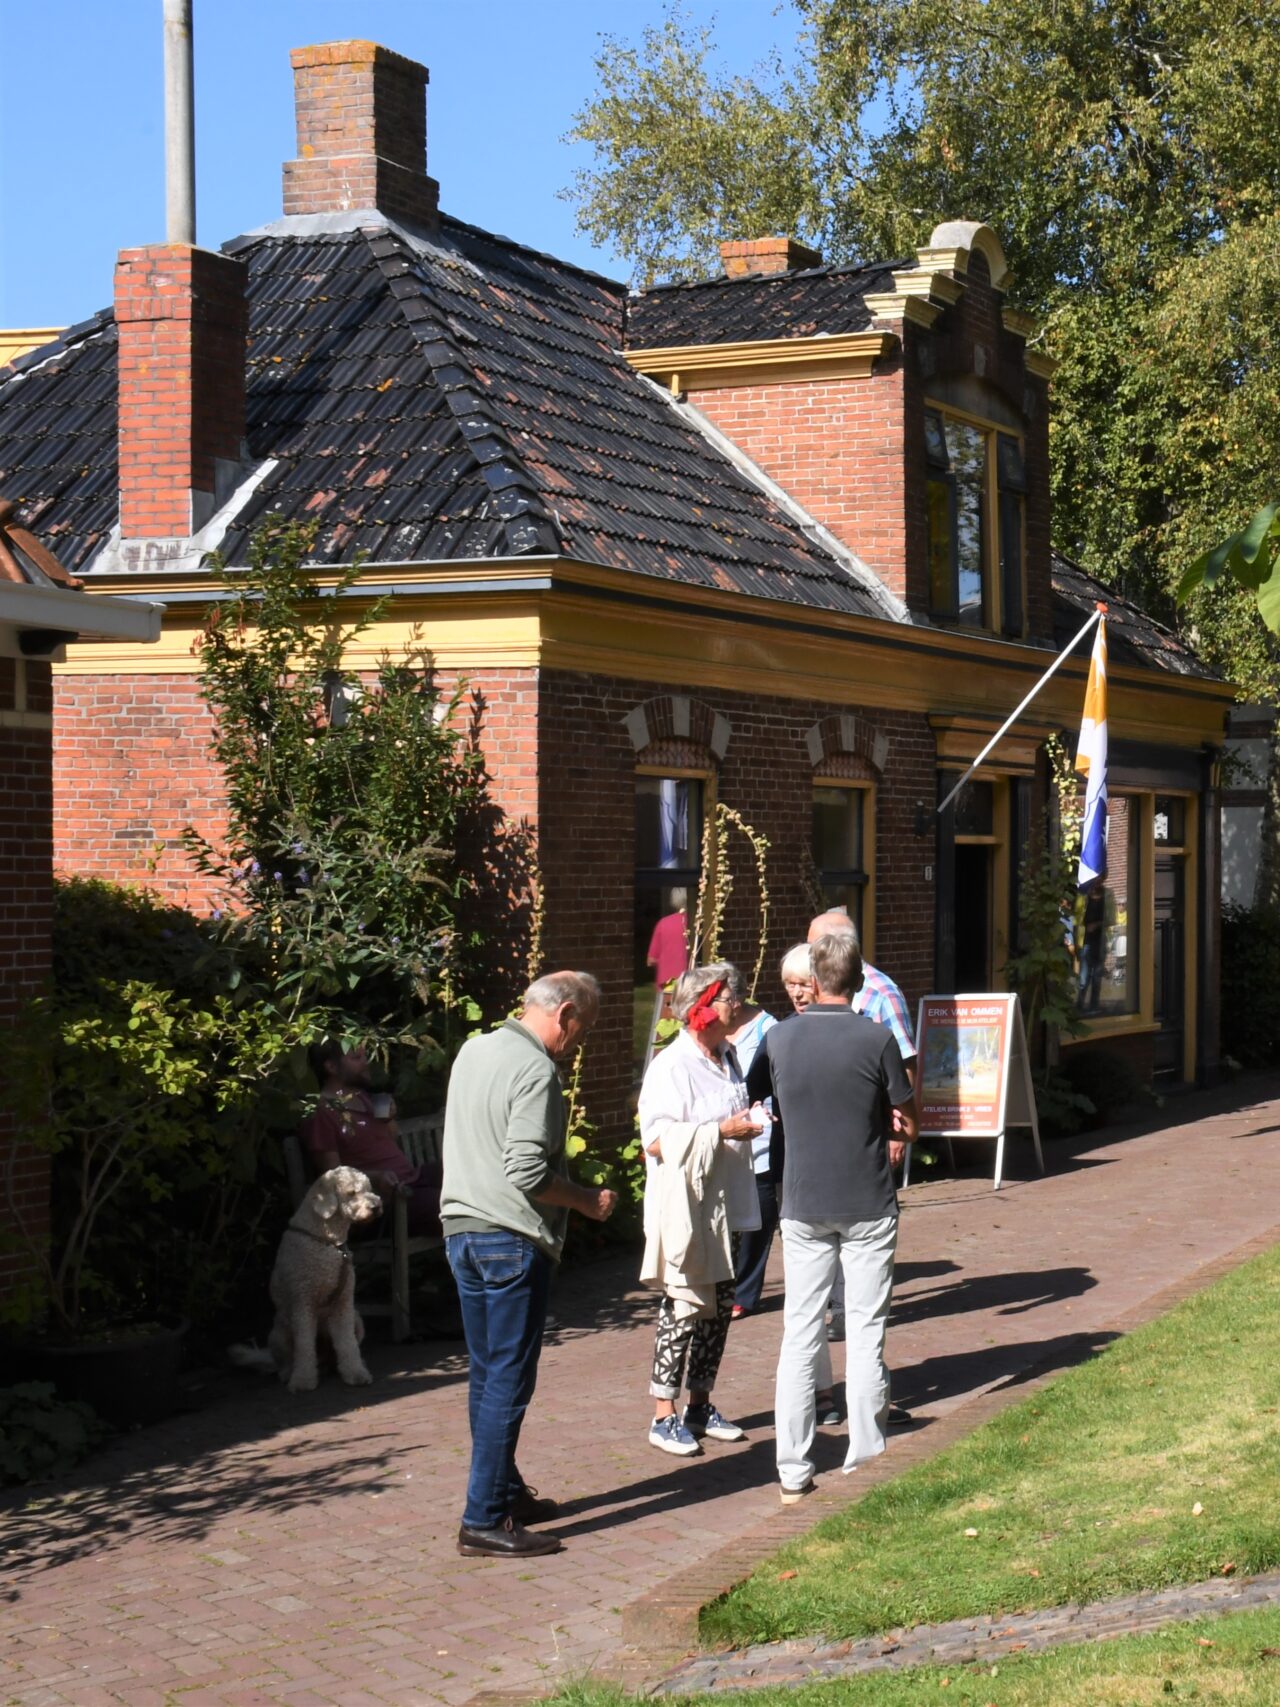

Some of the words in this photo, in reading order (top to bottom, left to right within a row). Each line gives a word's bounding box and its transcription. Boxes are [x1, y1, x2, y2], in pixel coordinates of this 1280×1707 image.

[928, 1008, 948, 1017] ERIK
[951, 1008, 968, 1016] VAN
[971, 1007, 1003, 1015] OMMEN
